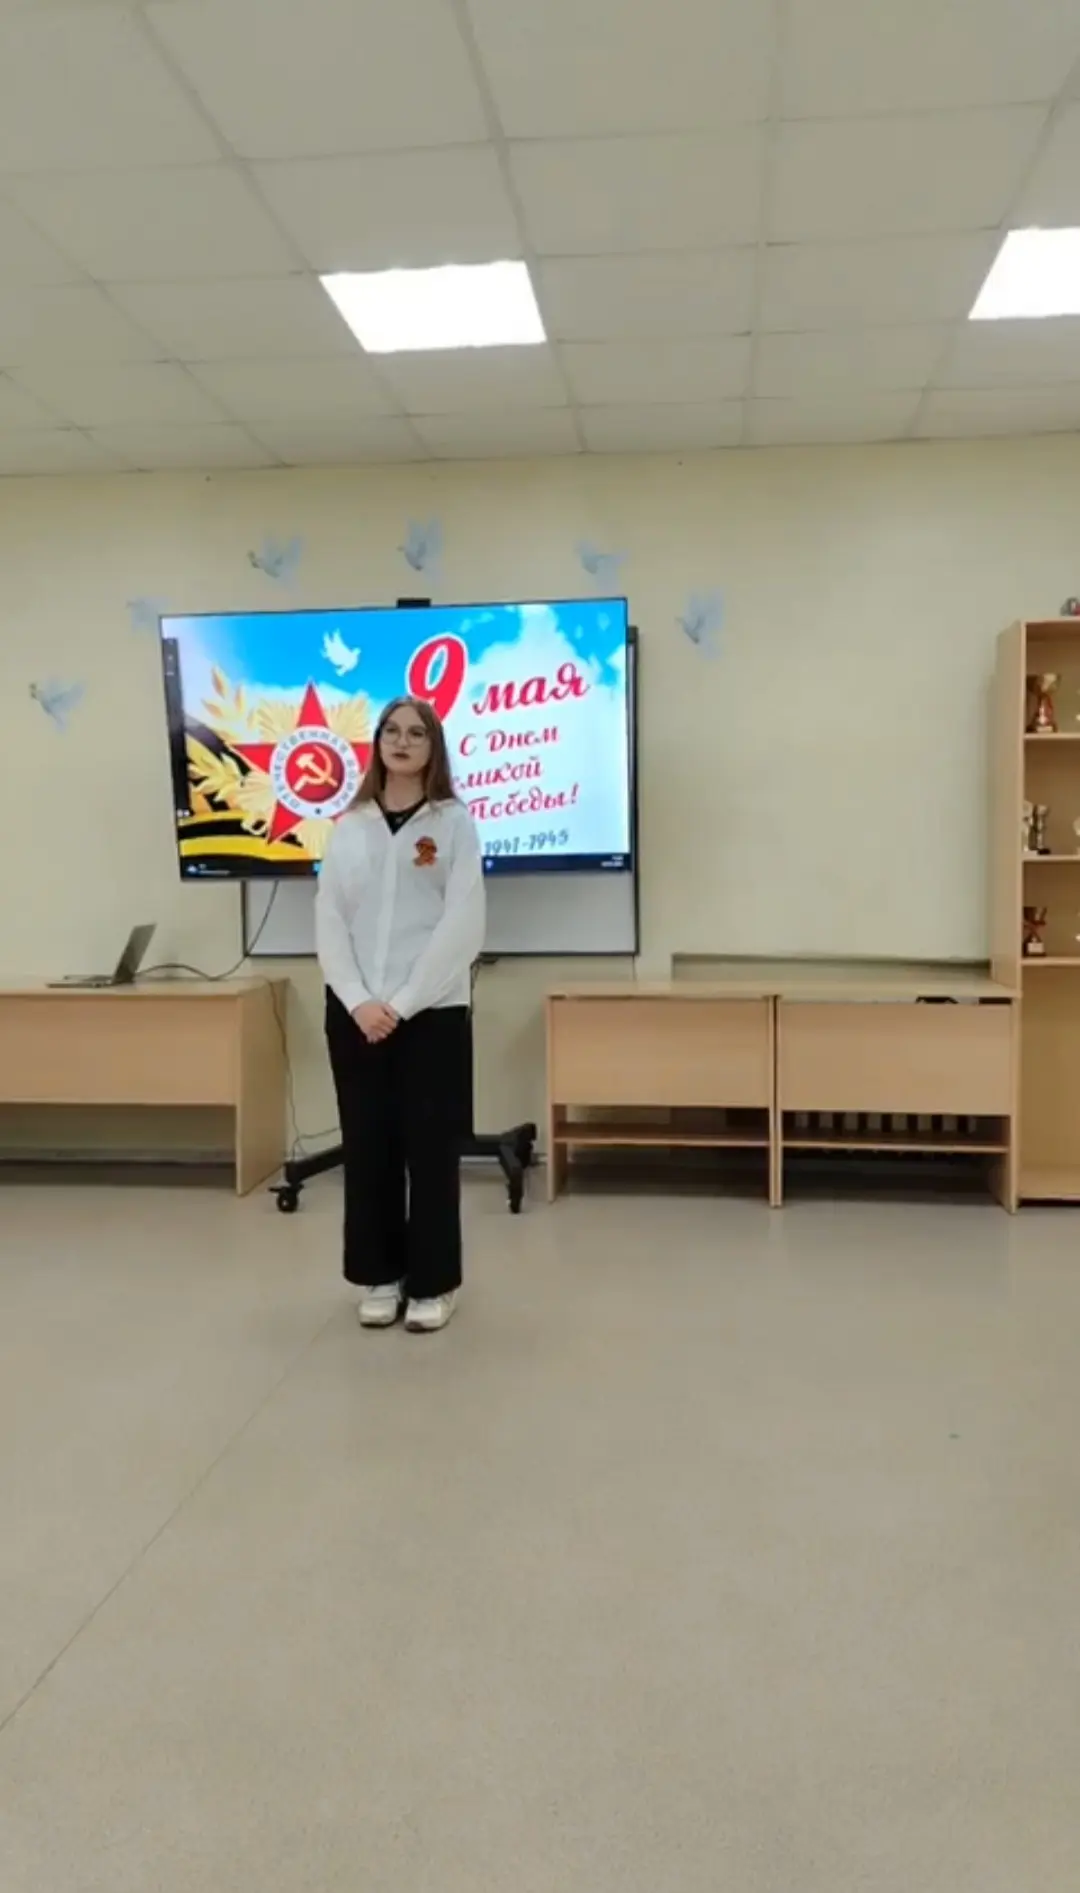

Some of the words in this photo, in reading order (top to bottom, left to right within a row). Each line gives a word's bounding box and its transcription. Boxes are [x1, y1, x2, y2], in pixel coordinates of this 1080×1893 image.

[406, 634, 467, 723] 9
[472, 662, 589, 716] мая
[486, 726, 559, 753] Днем
[452, 756, 543, 790] еликой
[468, 782, 580, 820] Победы!
[484, 829, 569, 855] 1941-1945
